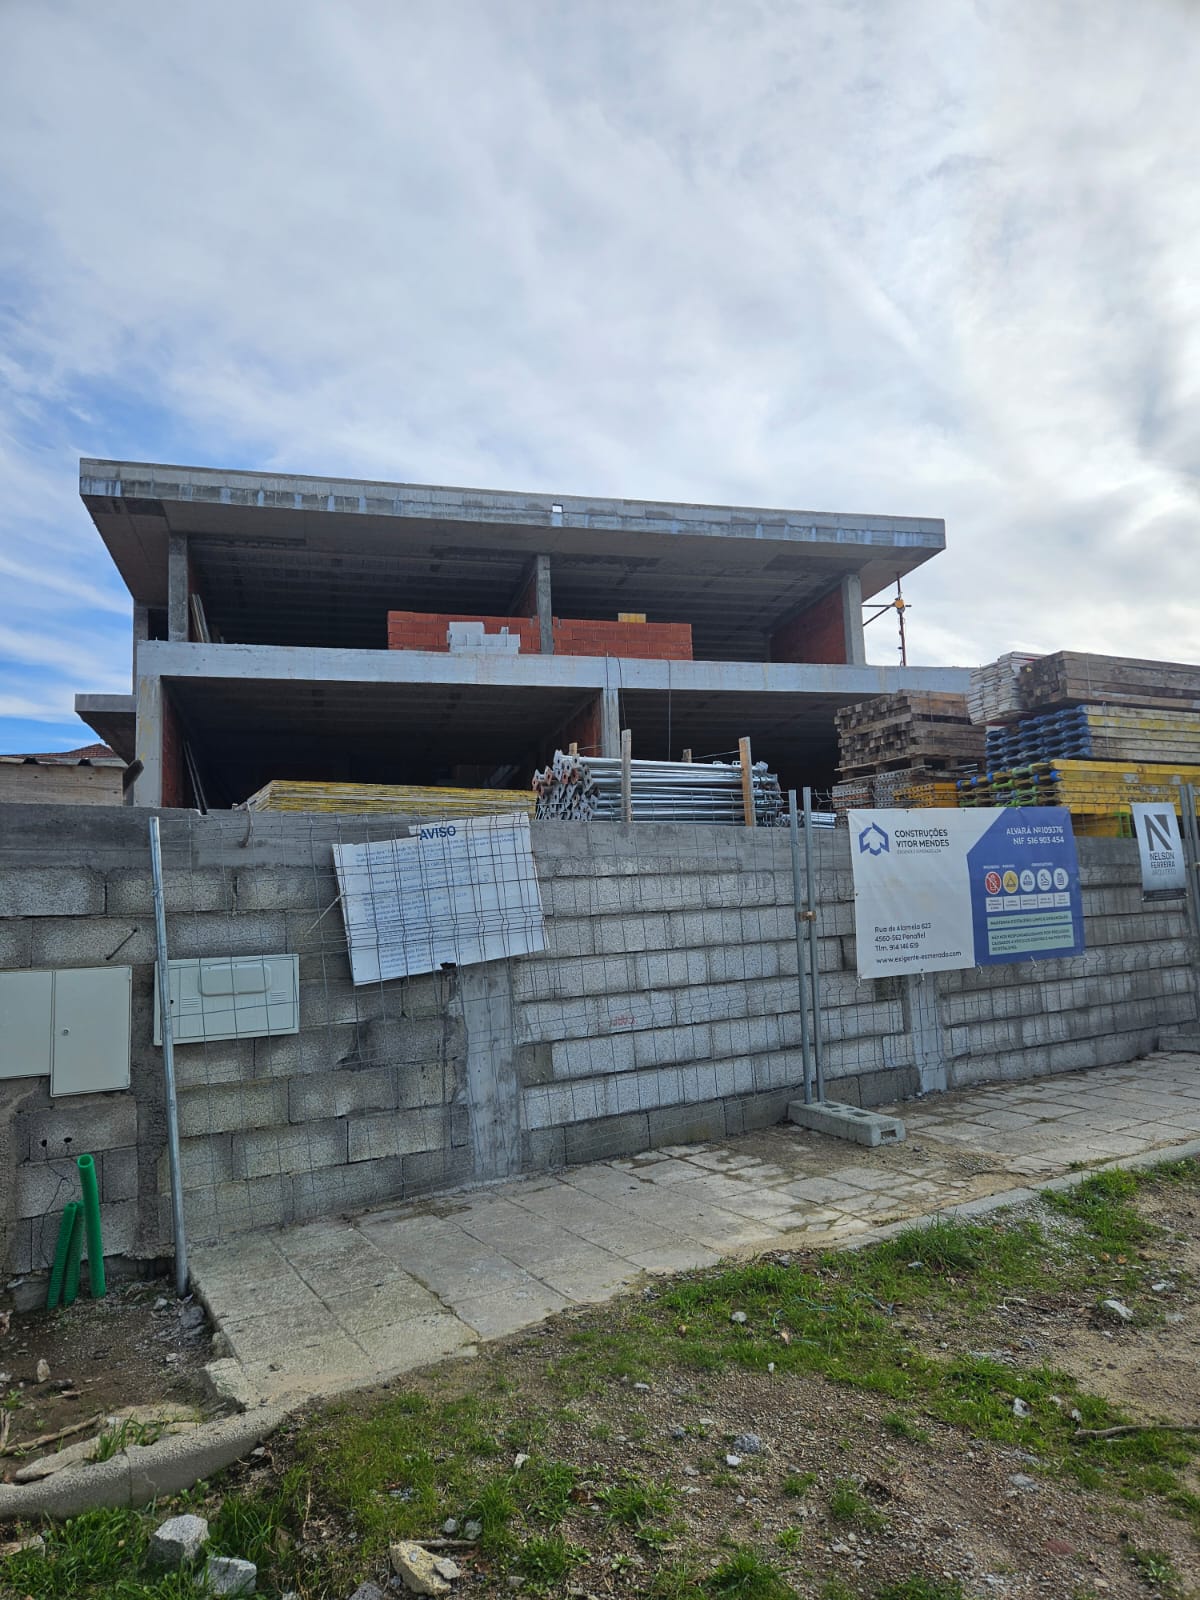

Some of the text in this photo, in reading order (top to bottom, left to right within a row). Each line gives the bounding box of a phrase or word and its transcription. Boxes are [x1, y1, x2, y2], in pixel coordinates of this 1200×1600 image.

[420, 826, 456, 840] AVISO
[894, 828, 948, 838] CONSTRUÇÕES
[1006, 826, 1032, 835] ALVARÁ
[1150, 852, 1174, 860] NELSON
[902, 932, 926, 940] Penafiel
